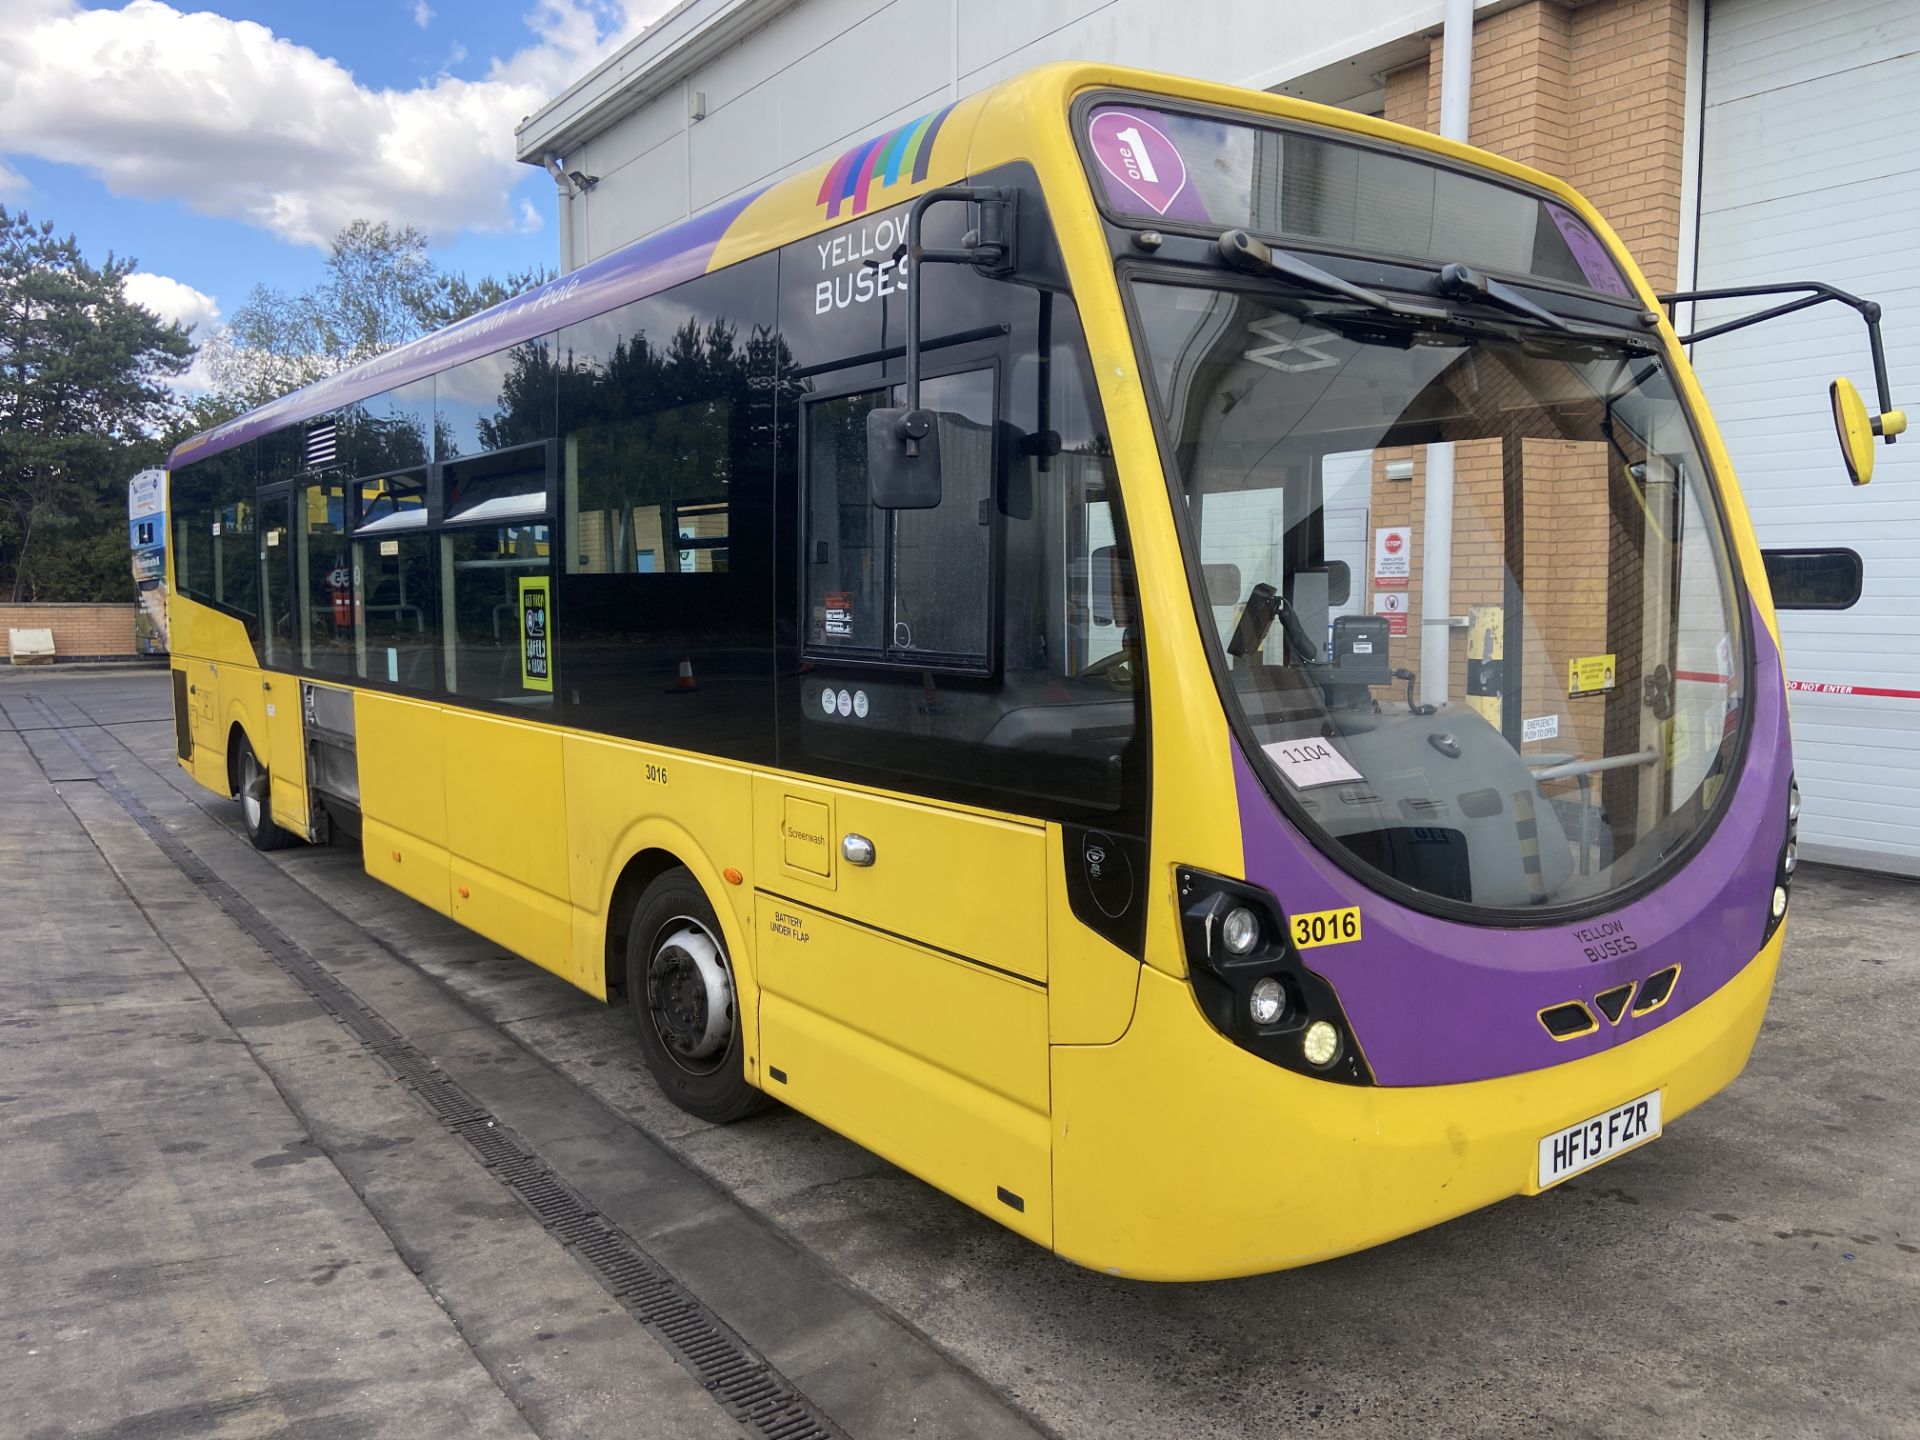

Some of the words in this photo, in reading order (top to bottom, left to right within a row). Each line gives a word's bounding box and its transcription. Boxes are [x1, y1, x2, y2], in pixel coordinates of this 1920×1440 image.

[1116, 127, 1159, 183] 1
[1119, 147, 1141, 180] one
[532, 274, 580, 313] Poole
[1386, 540, 1401, 548] STOP
[1800, 682, 1821, 692] NOT
[1822, 685, 1853, 694] ENTER
[1524, 730, 1537, 740] PUSH
[1537, 729, 1544, 738] TO
[1544, 727, 1556, 736] OPEN
[1526, 717, 1555, 730] EMERGENCY
[1282, 744, 1332, 764] 1104
[645, 763, 668, 785] 3016
[788, 827, 826, 846] Screenwash
[775, 911, 803, 929] BATTERY
[1296, 911, 1356, 945] 3016
[770, 921, 792, 936] UNDER
[792, 928, 810, 943] FLAP
[1572, 919, 1624, 944] YELLOW
[1583, 935, 1638, 963] BUSES
[1553, 1120, 1603, 1174] HF13
[1608, 1100, 1649, 1149] FZR
